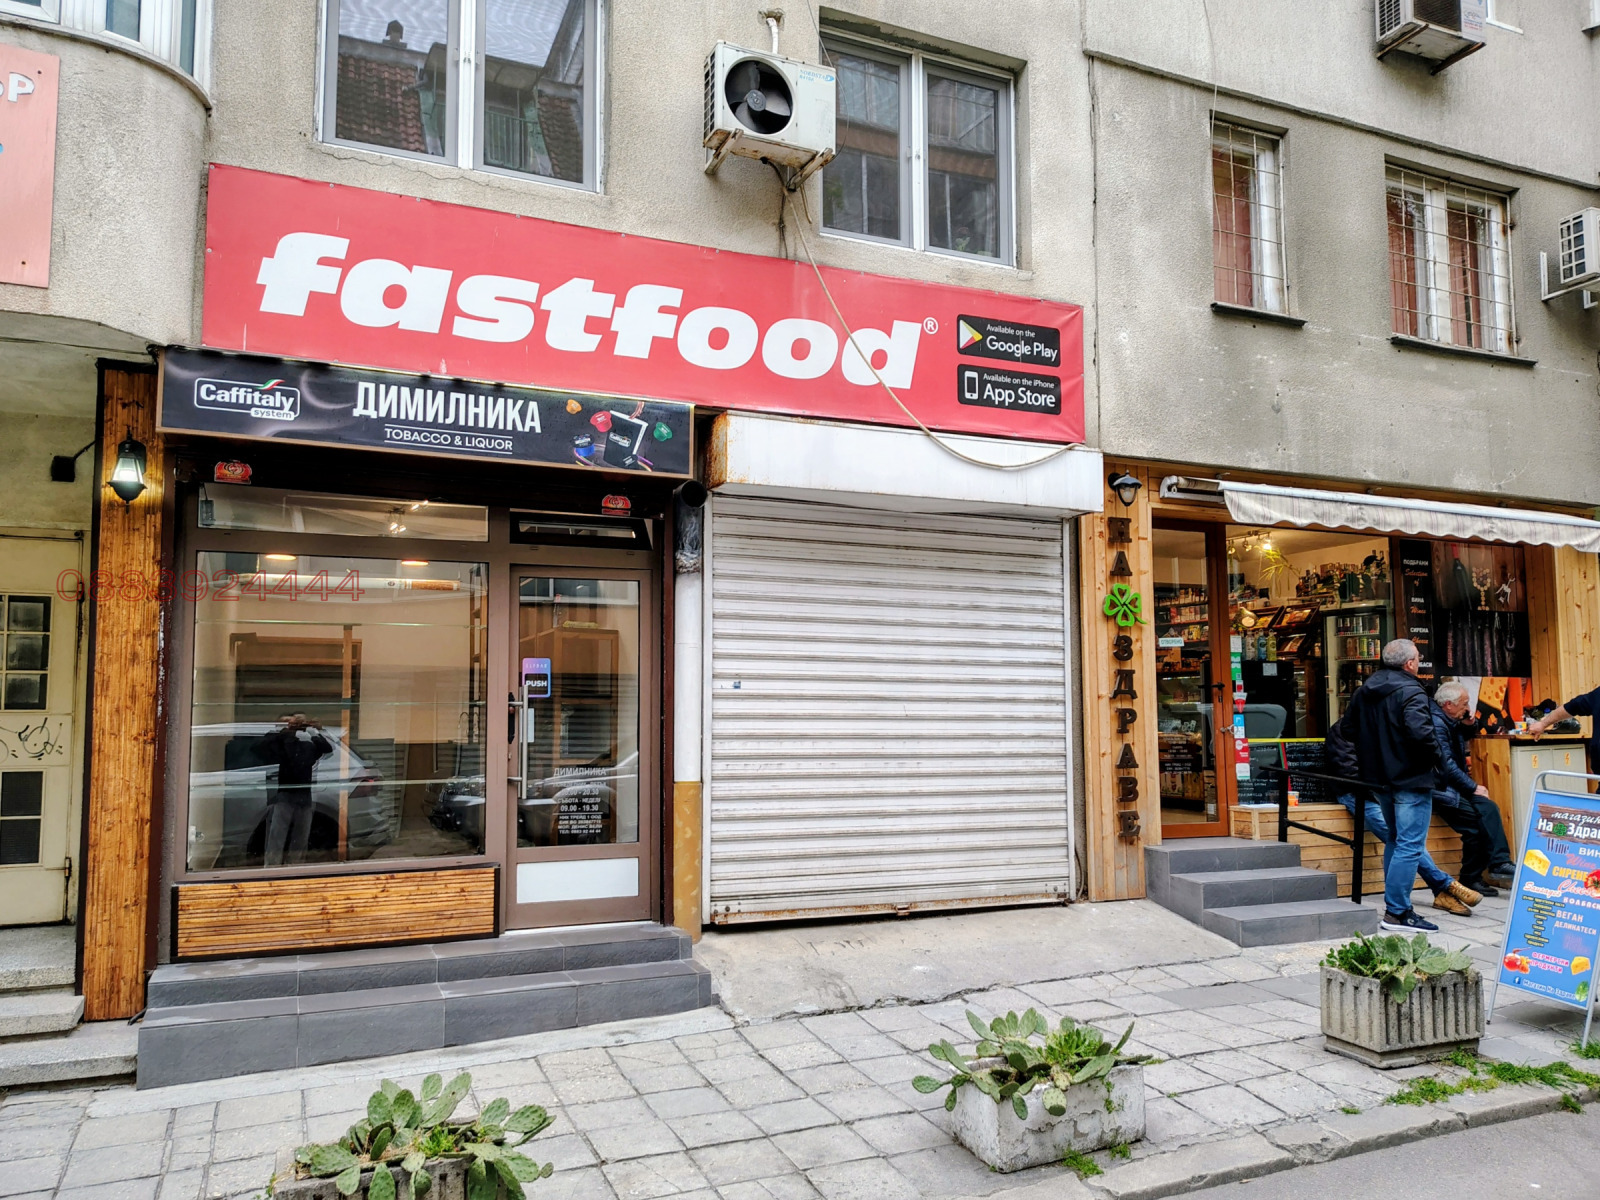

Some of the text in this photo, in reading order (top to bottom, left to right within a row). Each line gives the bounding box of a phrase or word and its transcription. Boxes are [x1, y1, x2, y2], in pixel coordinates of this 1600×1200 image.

[256, 232, 923, 390] fastfood
[986, 324, 1014, 335] Available
[1025, 330, 1036, 338] the
[986, 336, 1058, 361] Google Play
[983, 373, 1012, 384] Available
[1033, 380, 1055, 389] iPhone
[200, 383, 295, 412] Caffitaly
[983, 383, 1056, 407] App Store
[253, 409, 292, 419] system
[353, 381, 541, 433] ДИМИЛНИКА
[384, 428, 513, 451] TOBACCO & LIQUOR
[1109, 634, 1142, 839] ЗДРАВЕ
[1538, 818, 1600, 839] На Здра
[1552, 866, 1588, 882] СИРЕНЕ
[1556, 910, 1583, 922] ВЕГАН
[1554, 920, 1597, 935] ДЕЛИКАТЕСИ
